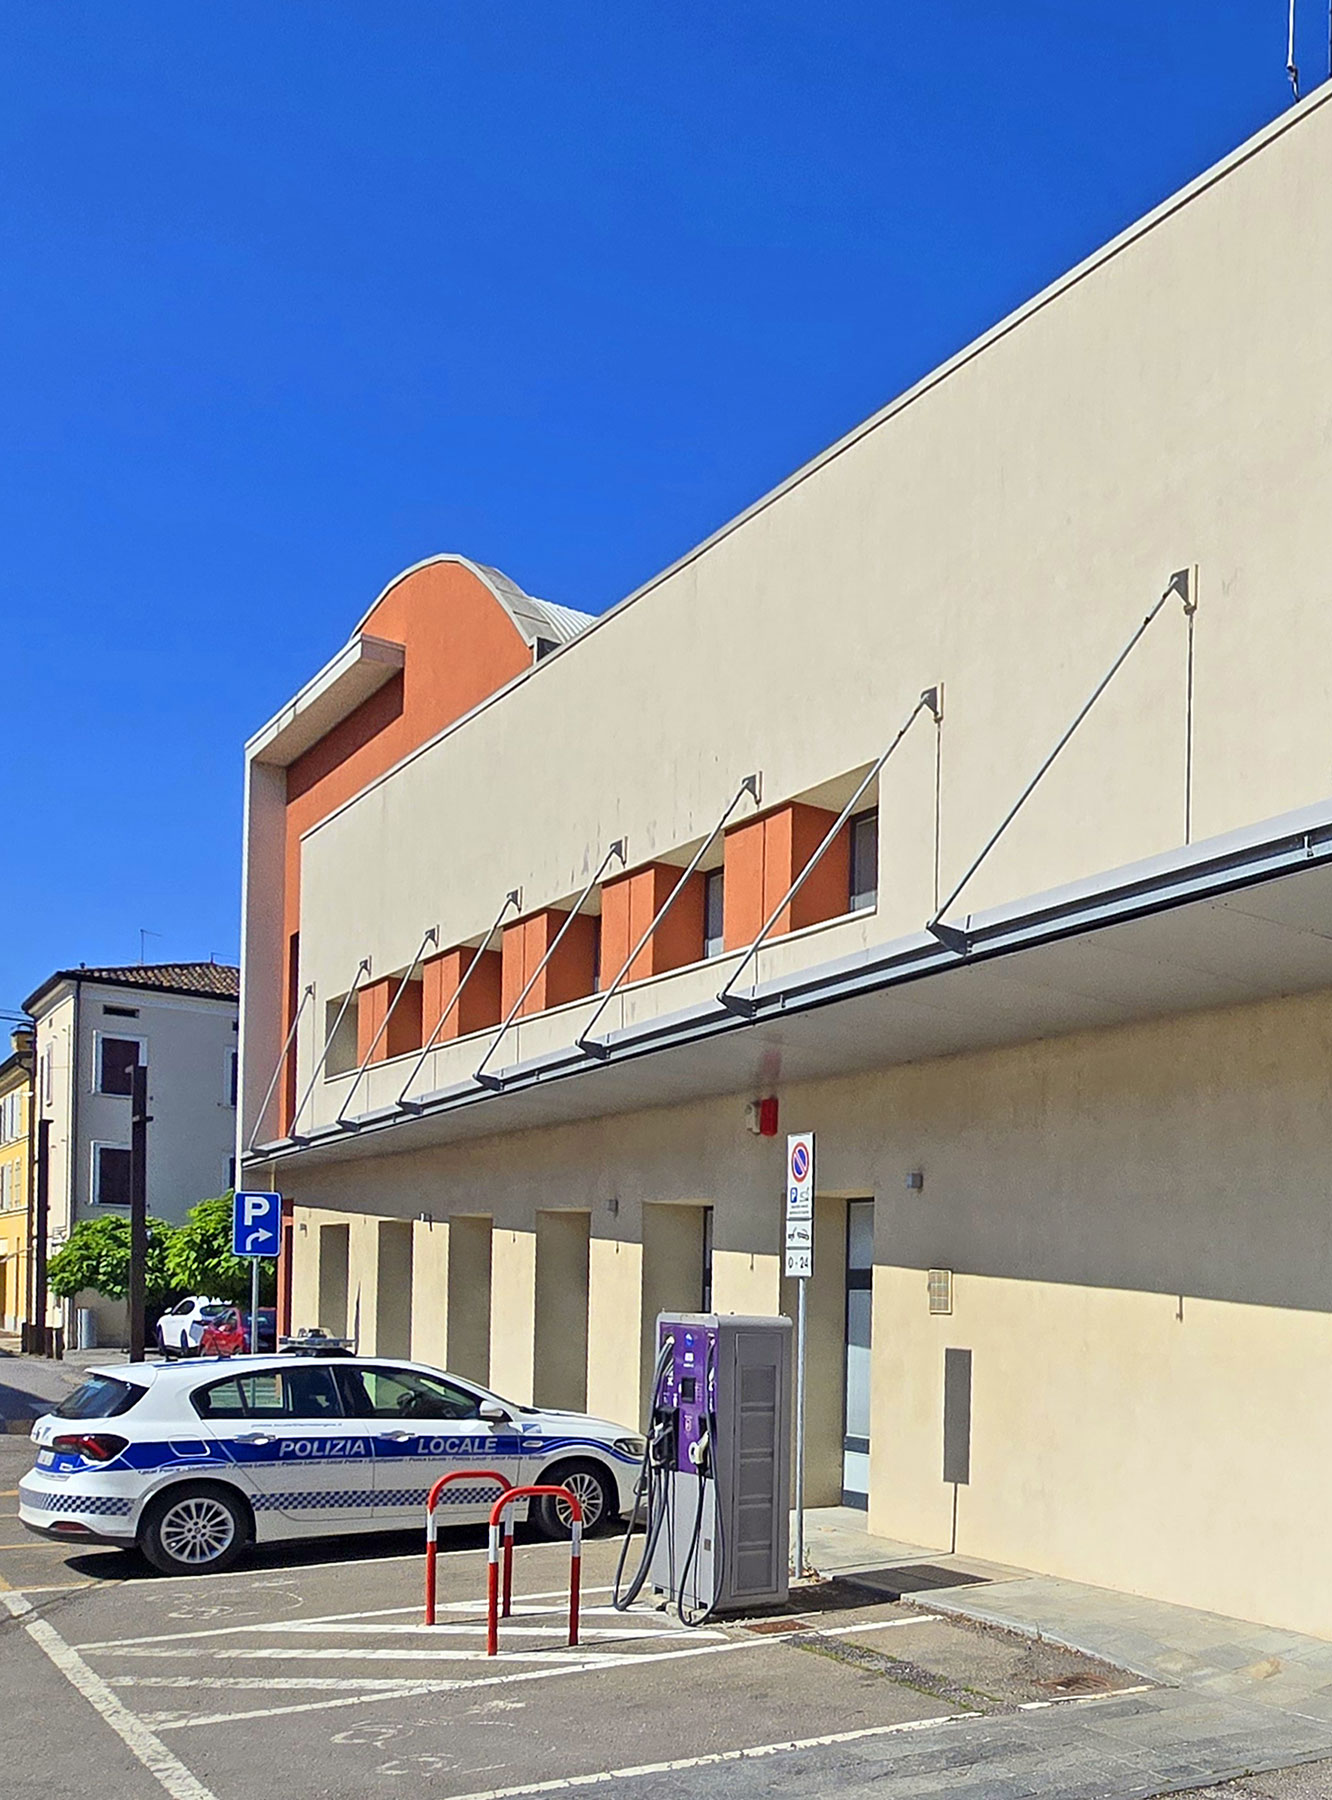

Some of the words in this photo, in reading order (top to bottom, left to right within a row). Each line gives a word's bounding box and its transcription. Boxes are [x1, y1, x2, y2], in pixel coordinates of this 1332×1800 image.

[244, 1196, 270, 1226] P
[279, 1439, 366, 1457] POLIZIA
[417, 1437, 498, 1454] LOCALE
